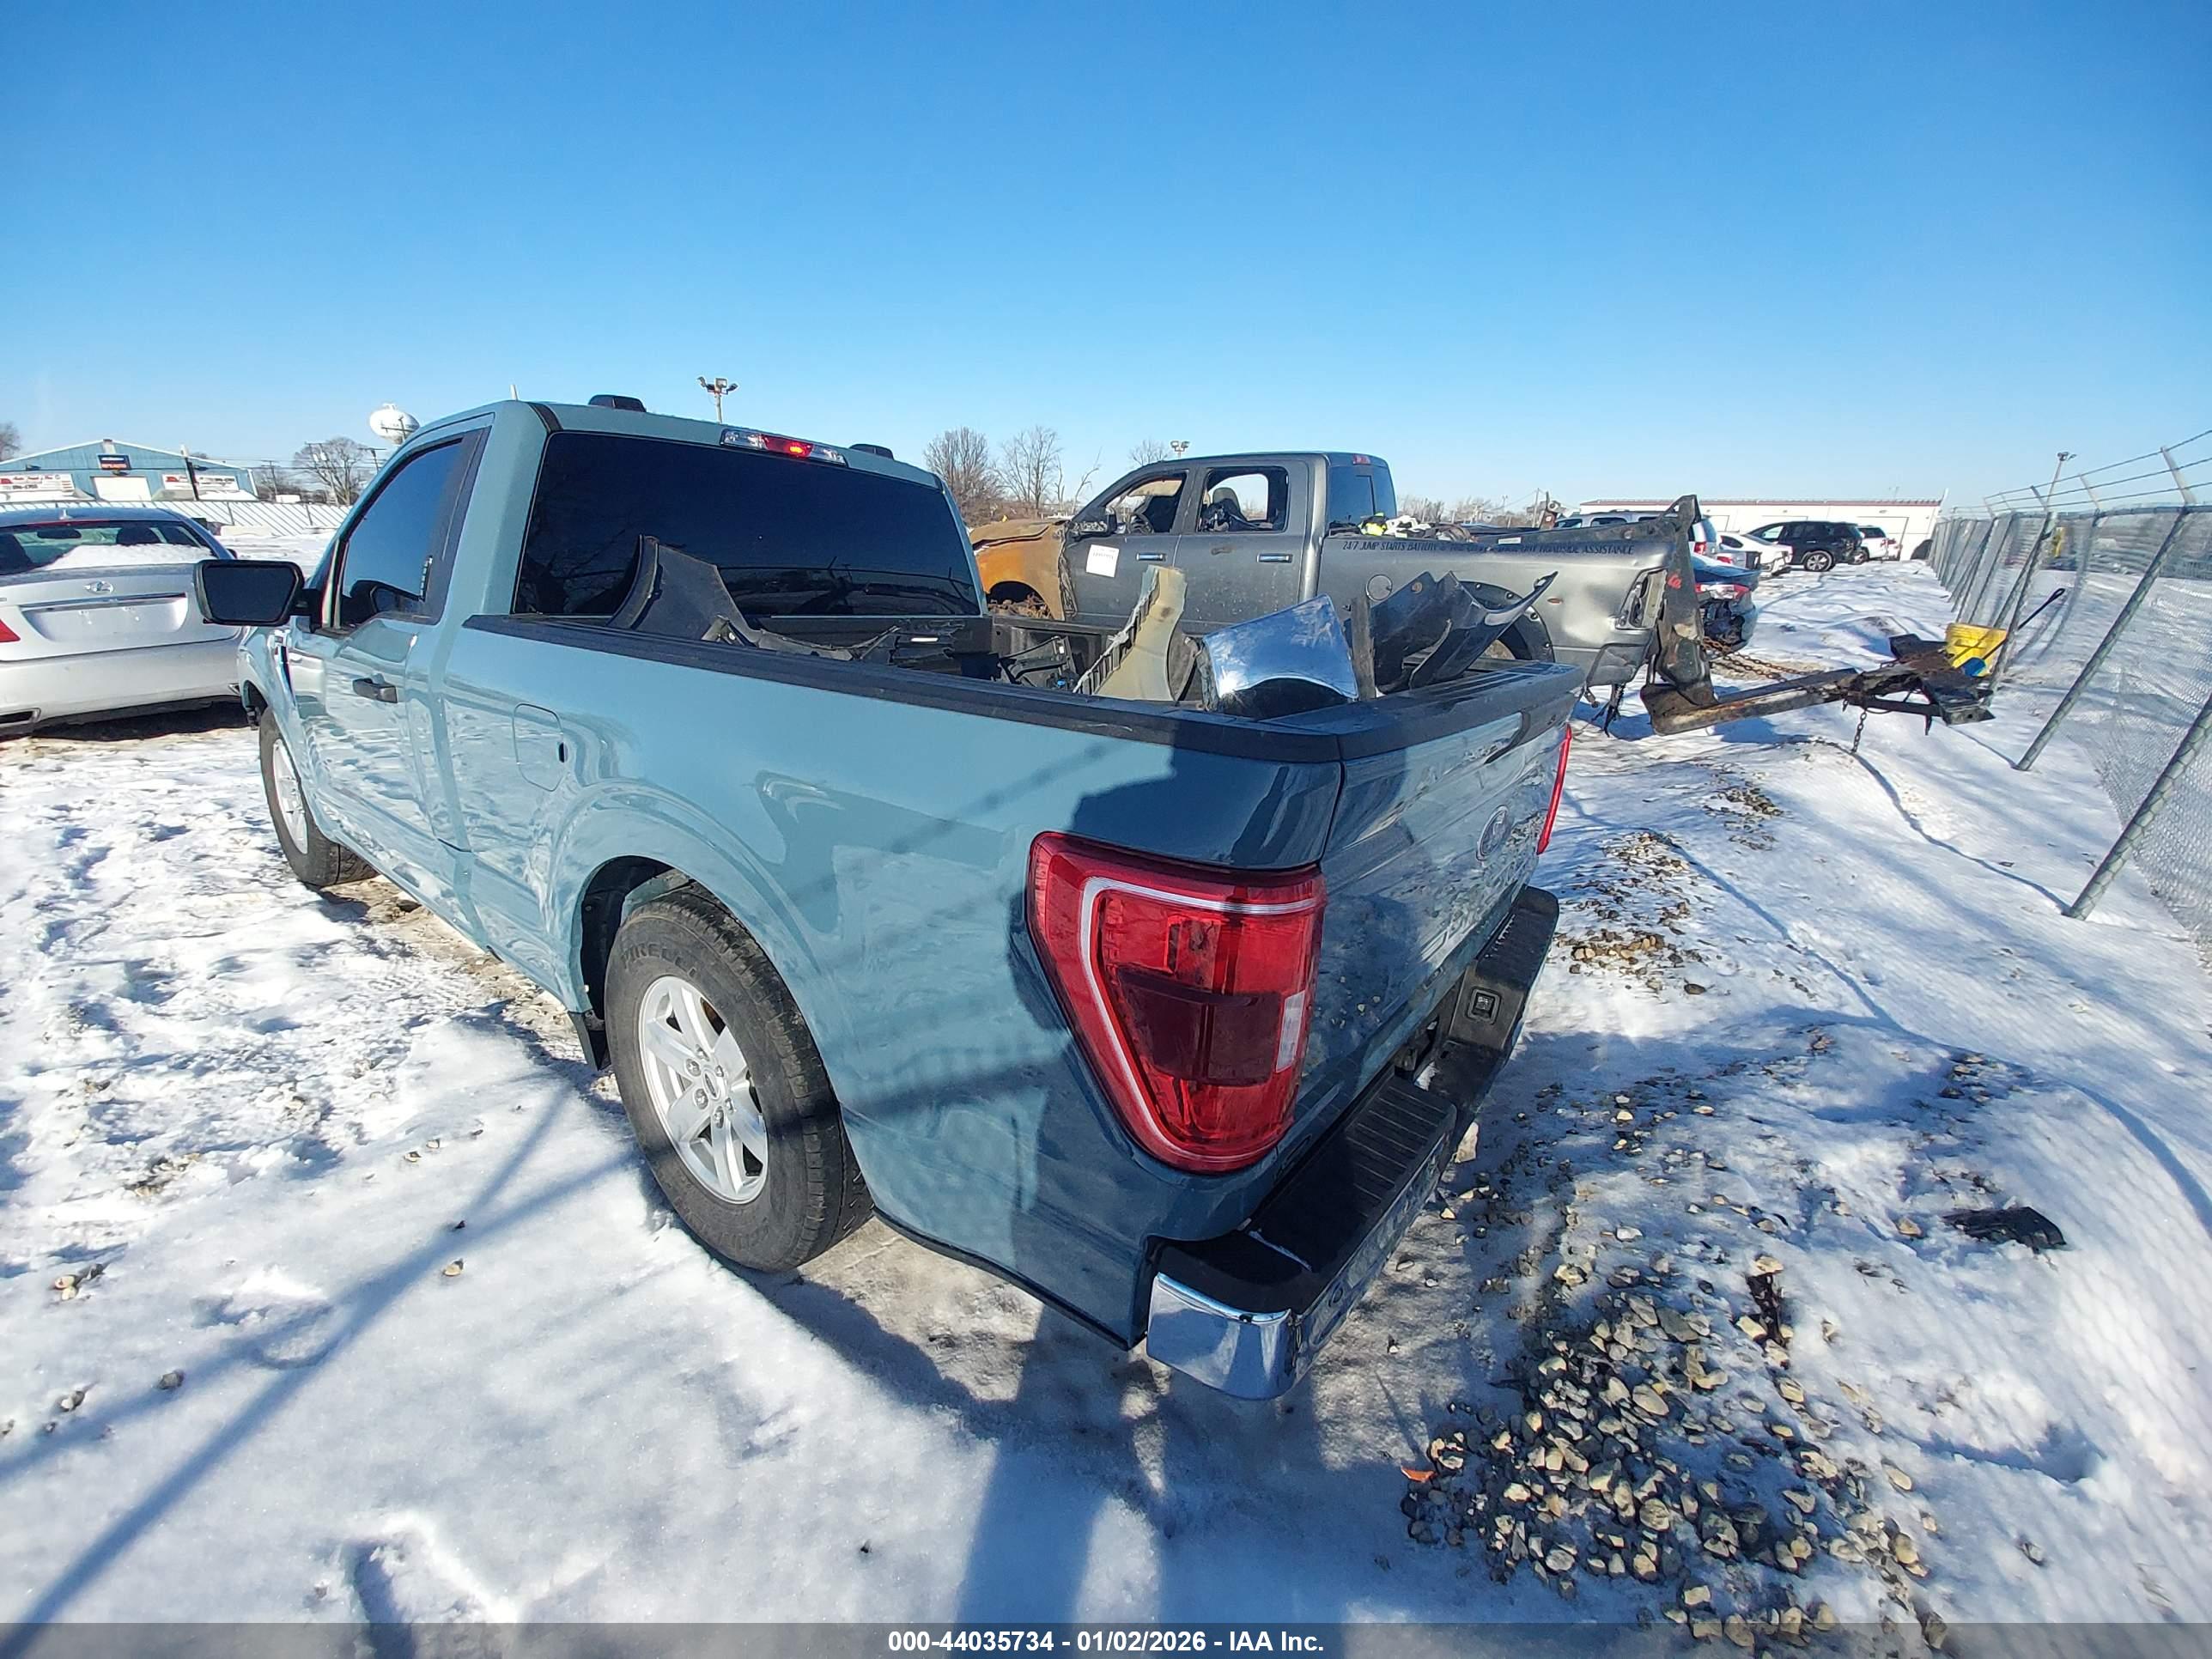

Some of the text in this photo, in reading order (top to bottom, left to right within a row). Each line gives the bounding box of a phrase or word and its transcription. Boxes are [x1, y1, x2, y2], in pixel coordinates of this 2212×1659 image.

[1359, 541, 1380, 550] JUMP
[1381, 541, 1406, 550] STARTS
[1584, 544, 1634, 555] ASSISTANCE
[620, 942, 697, 977] PIRELLI
